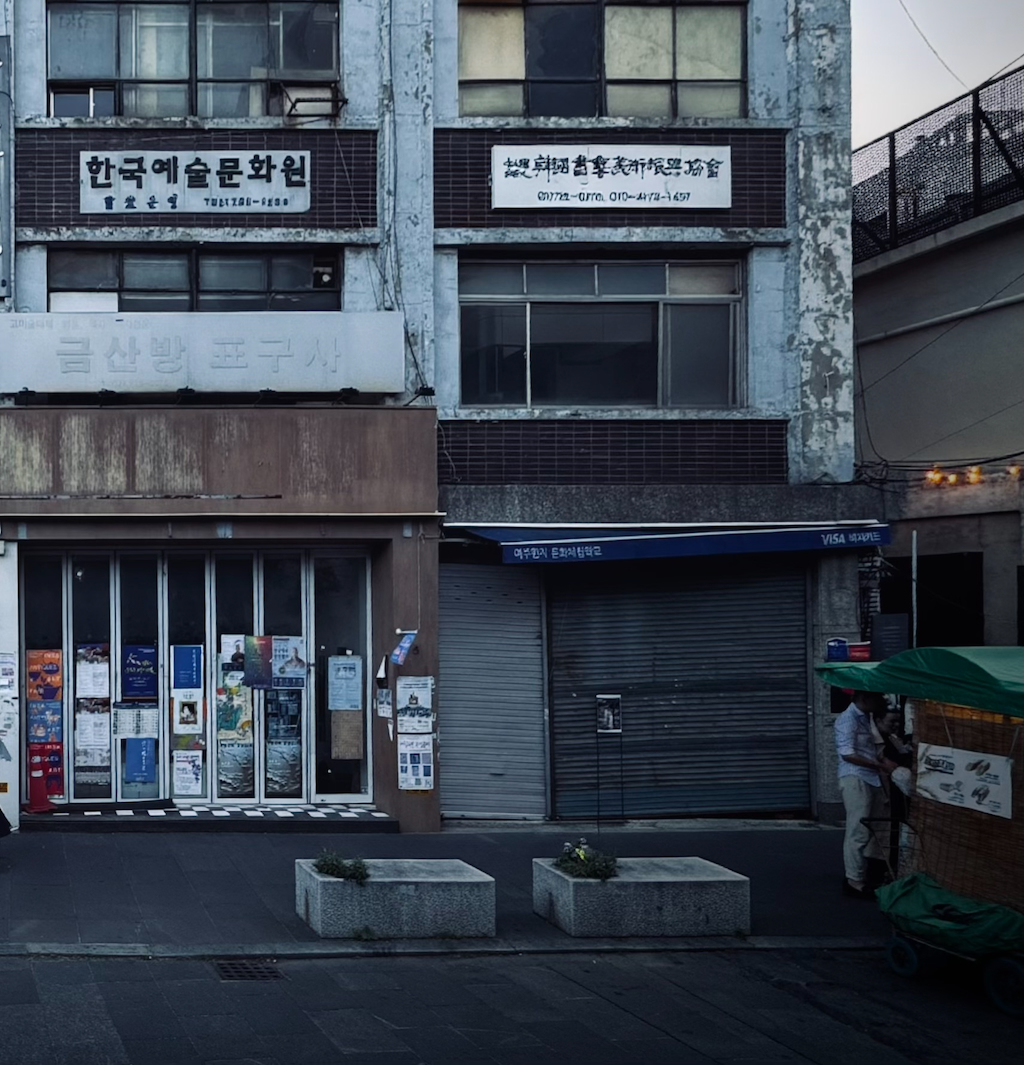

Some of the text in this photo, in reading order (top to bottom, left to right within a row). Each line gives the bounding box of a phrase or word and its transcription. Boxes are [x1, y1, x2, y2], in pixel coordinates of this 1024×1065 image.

[86, 155, 307, 189] 한국예술문화원
[56, 335, 342, 373] 금산방 표구사
[821, 533, 846, 546] VISA
